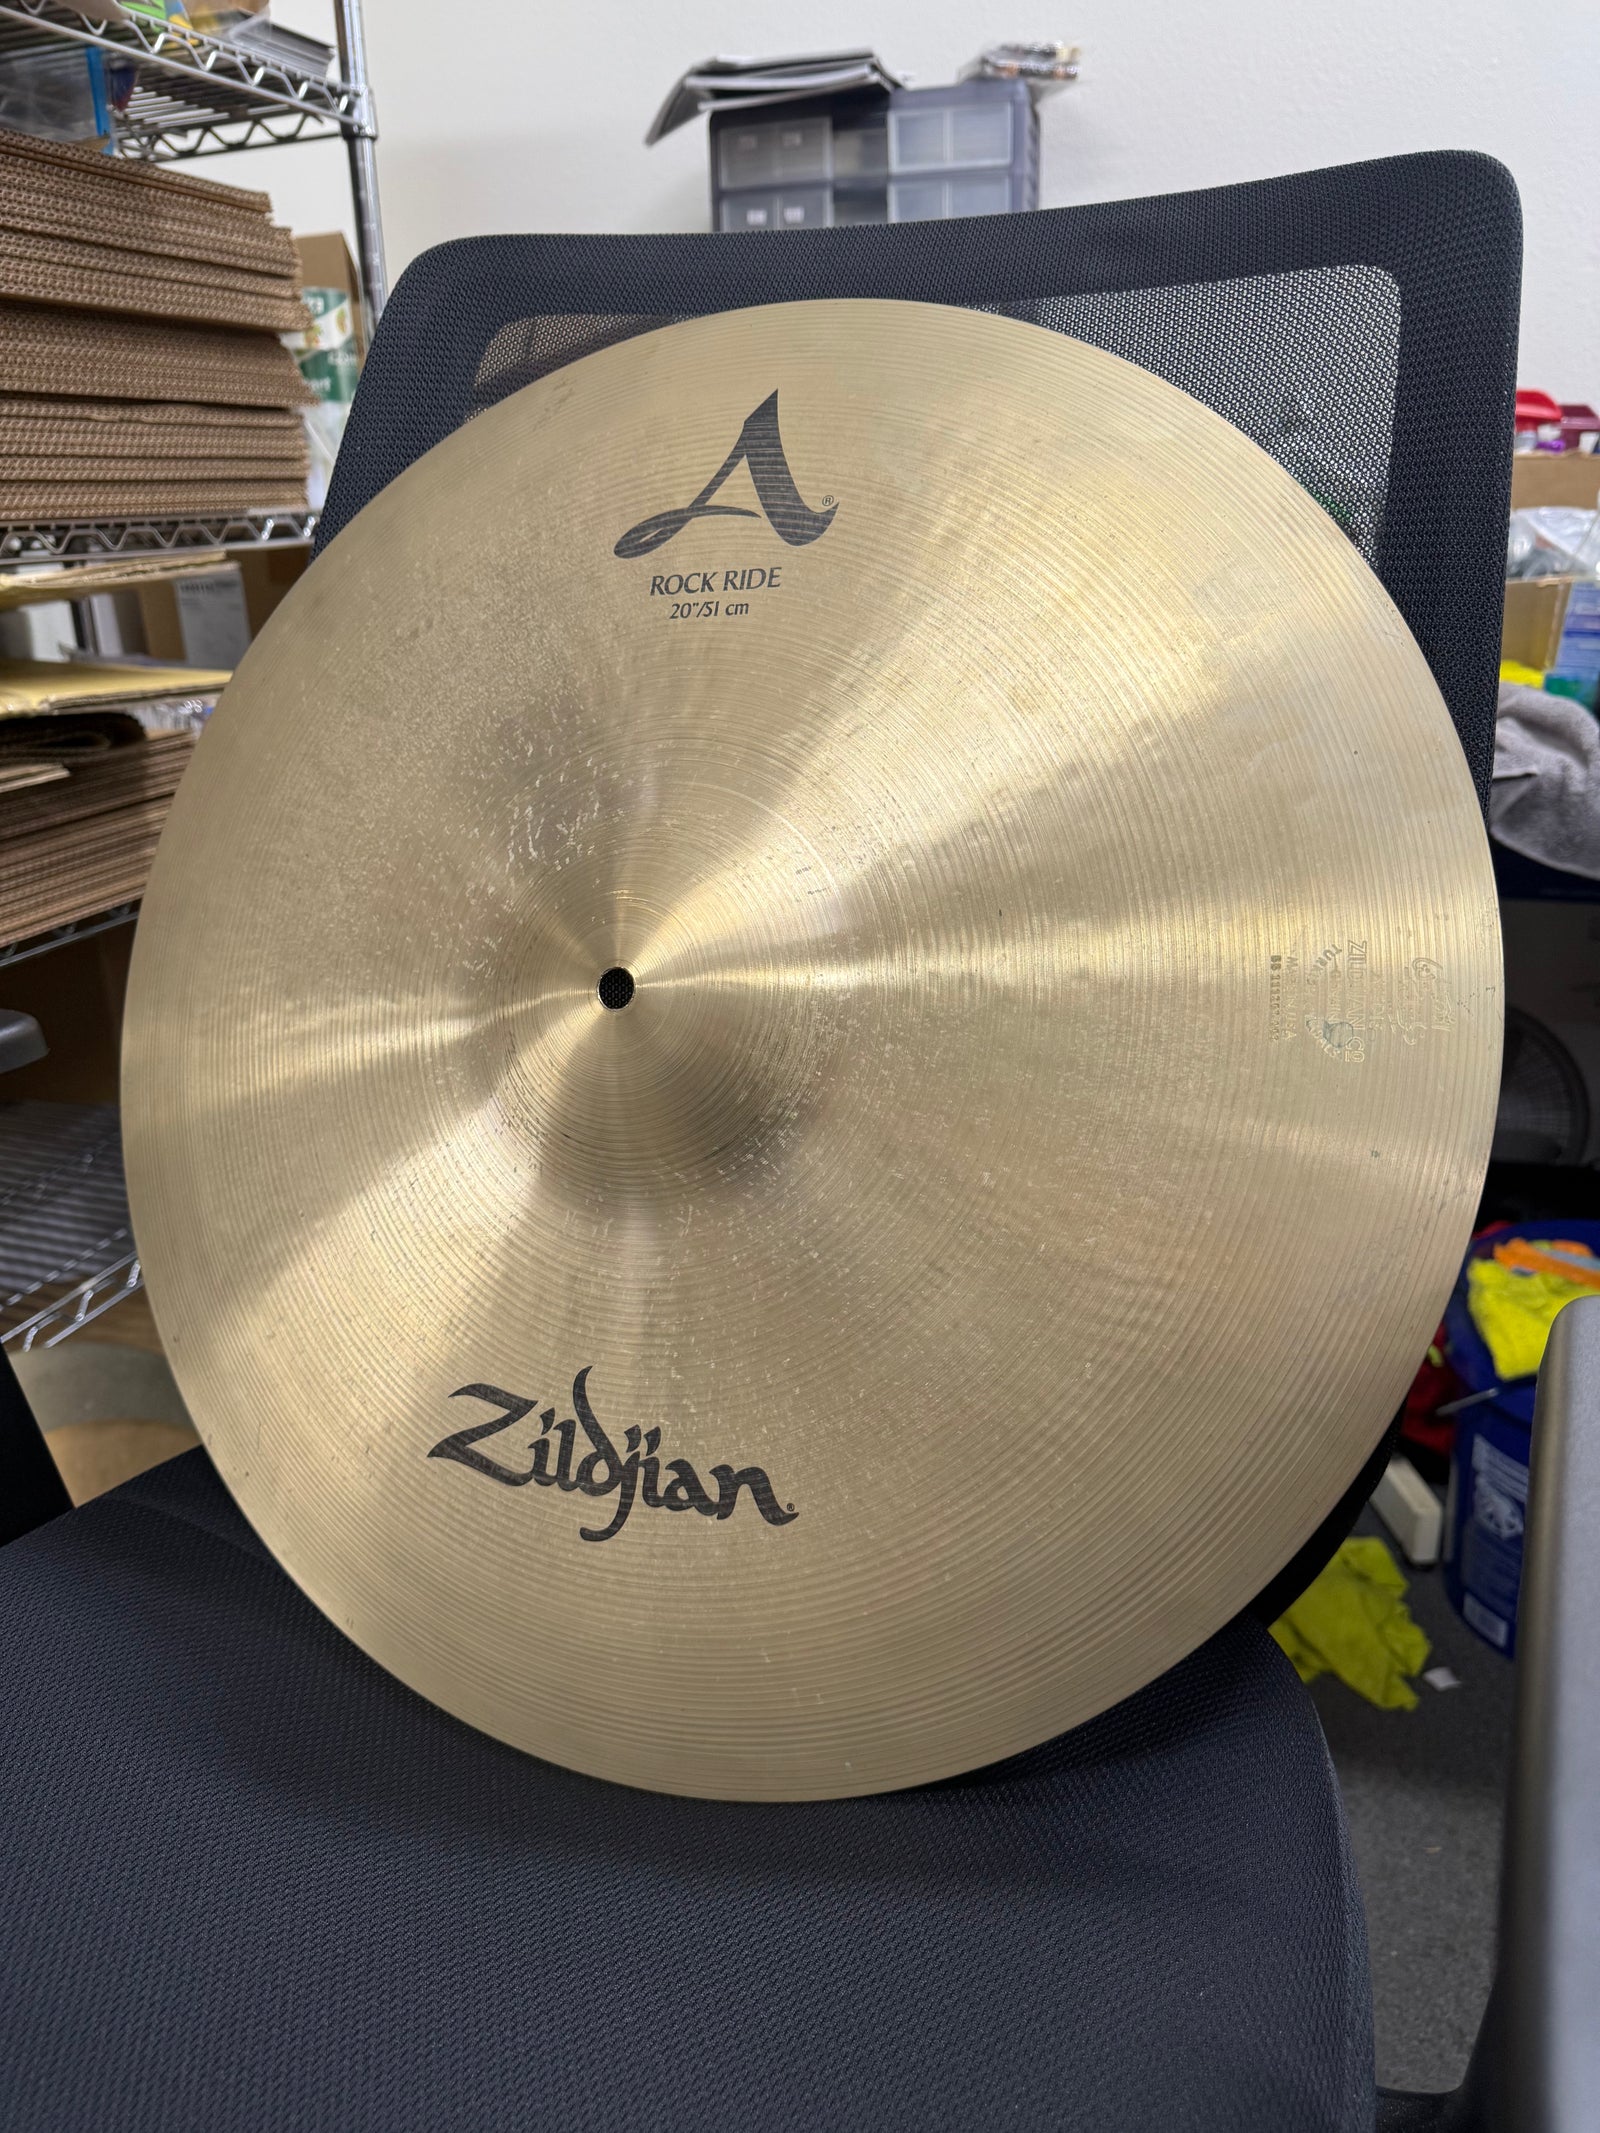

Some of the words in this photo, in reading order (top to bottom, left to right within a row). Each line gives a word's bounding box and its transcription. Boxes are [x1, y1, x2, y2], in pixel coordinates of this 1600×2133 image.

[650, 571, 718, 596] ROCK
[723, 567, 782, 591] RIDE
[725, 601, 749, 616] cm
[427, 1365, 799, 1541] Zildjian
